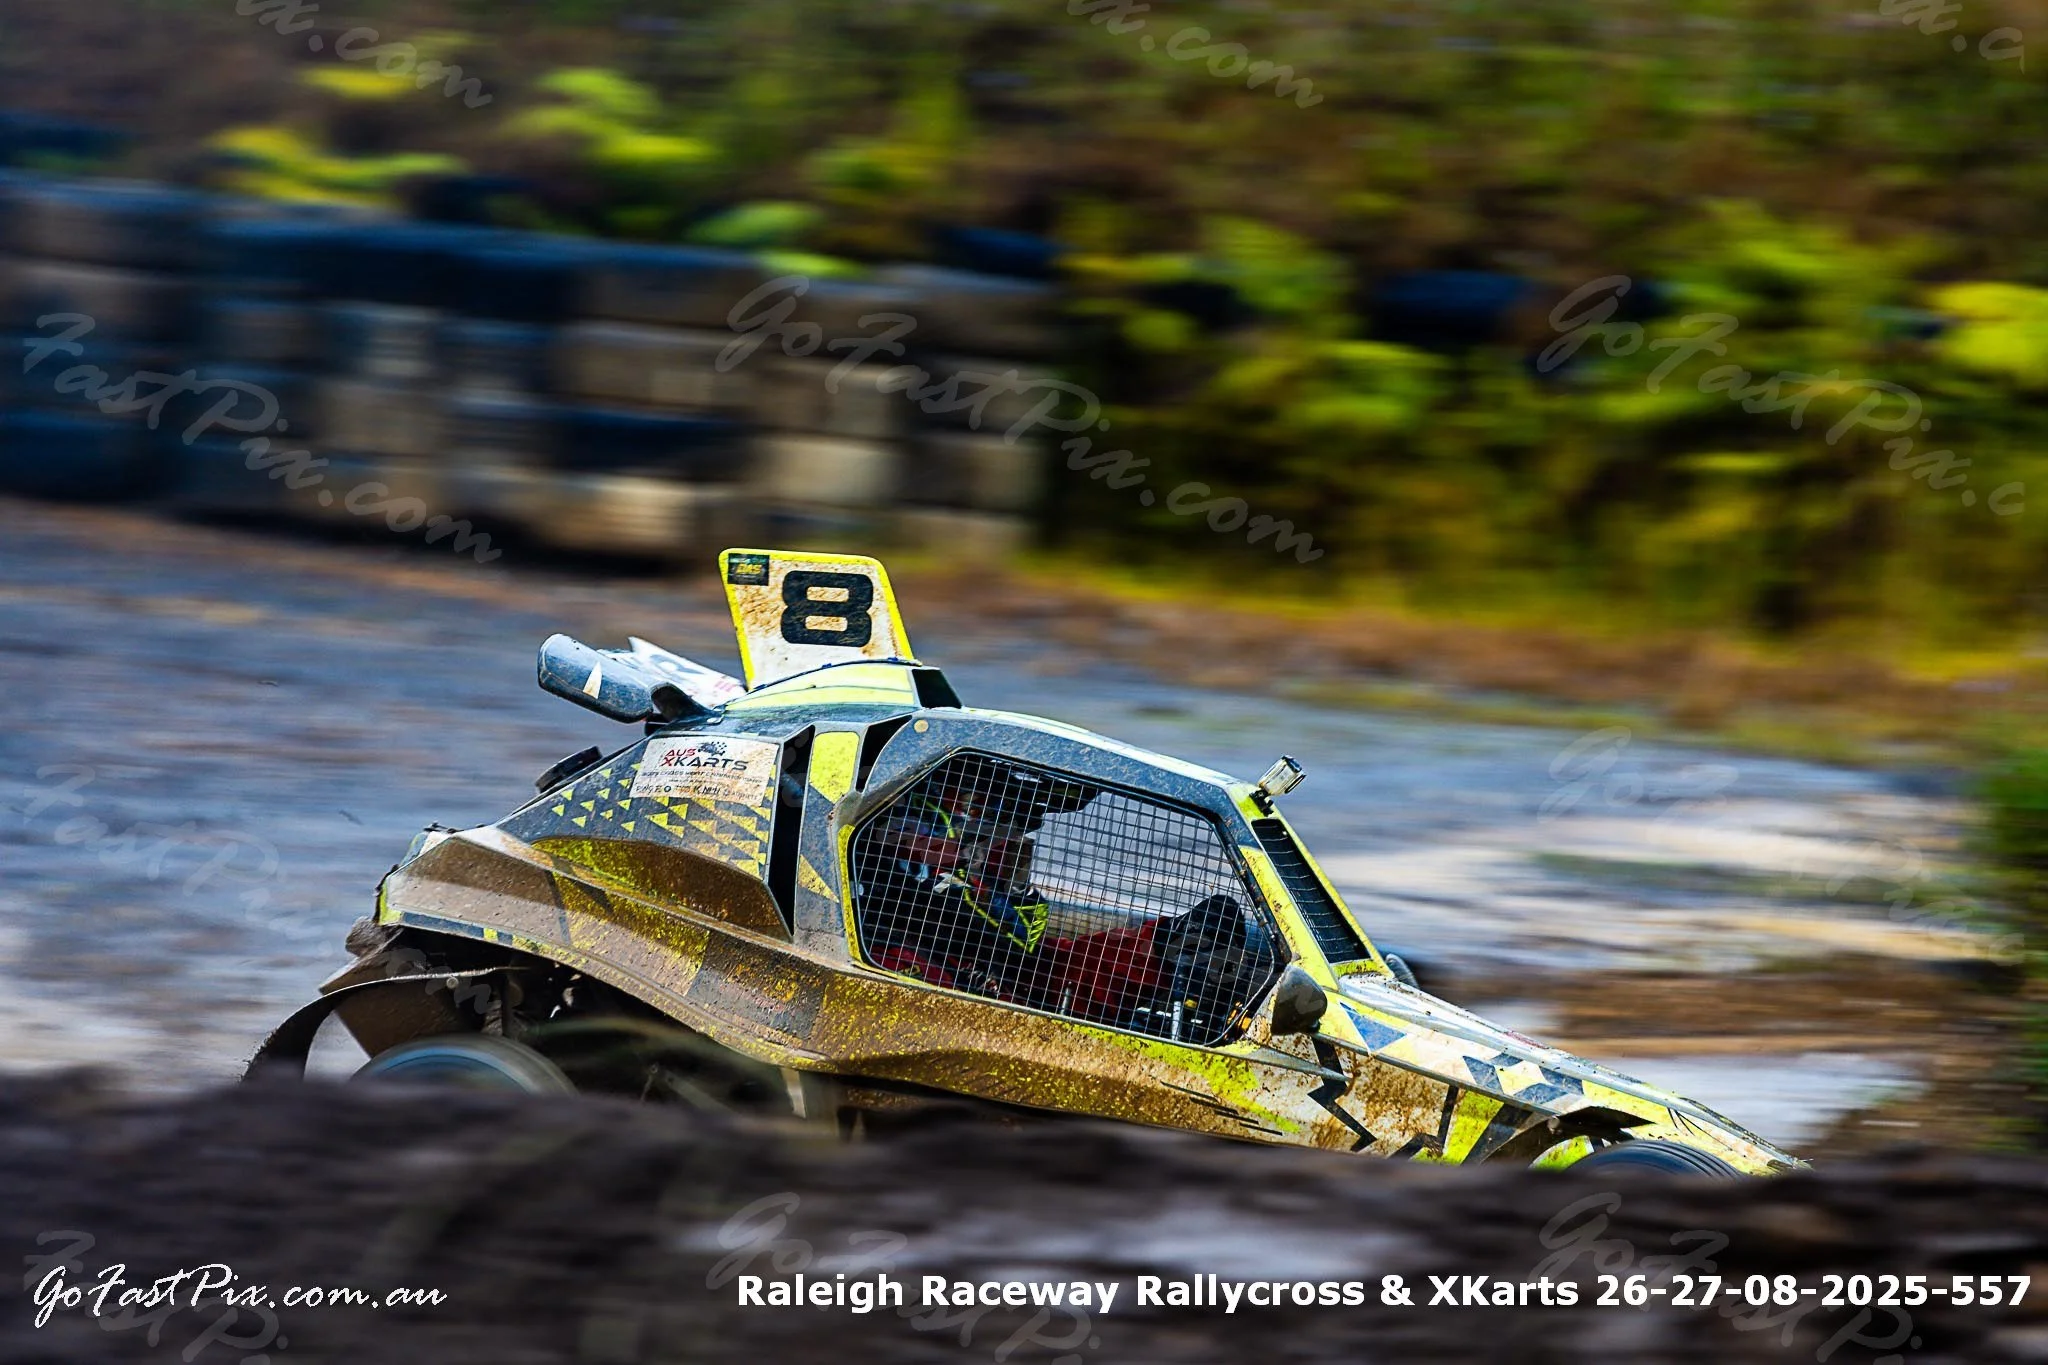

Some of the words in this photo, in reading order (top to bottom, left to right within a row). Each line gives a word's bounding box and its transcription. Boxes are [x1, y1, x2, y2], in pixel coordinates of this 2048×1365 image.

[781, 571, 874, 647] 8
[664, 749, 697, 757] AUS
[659, 756, 749, 771] XKARTS
